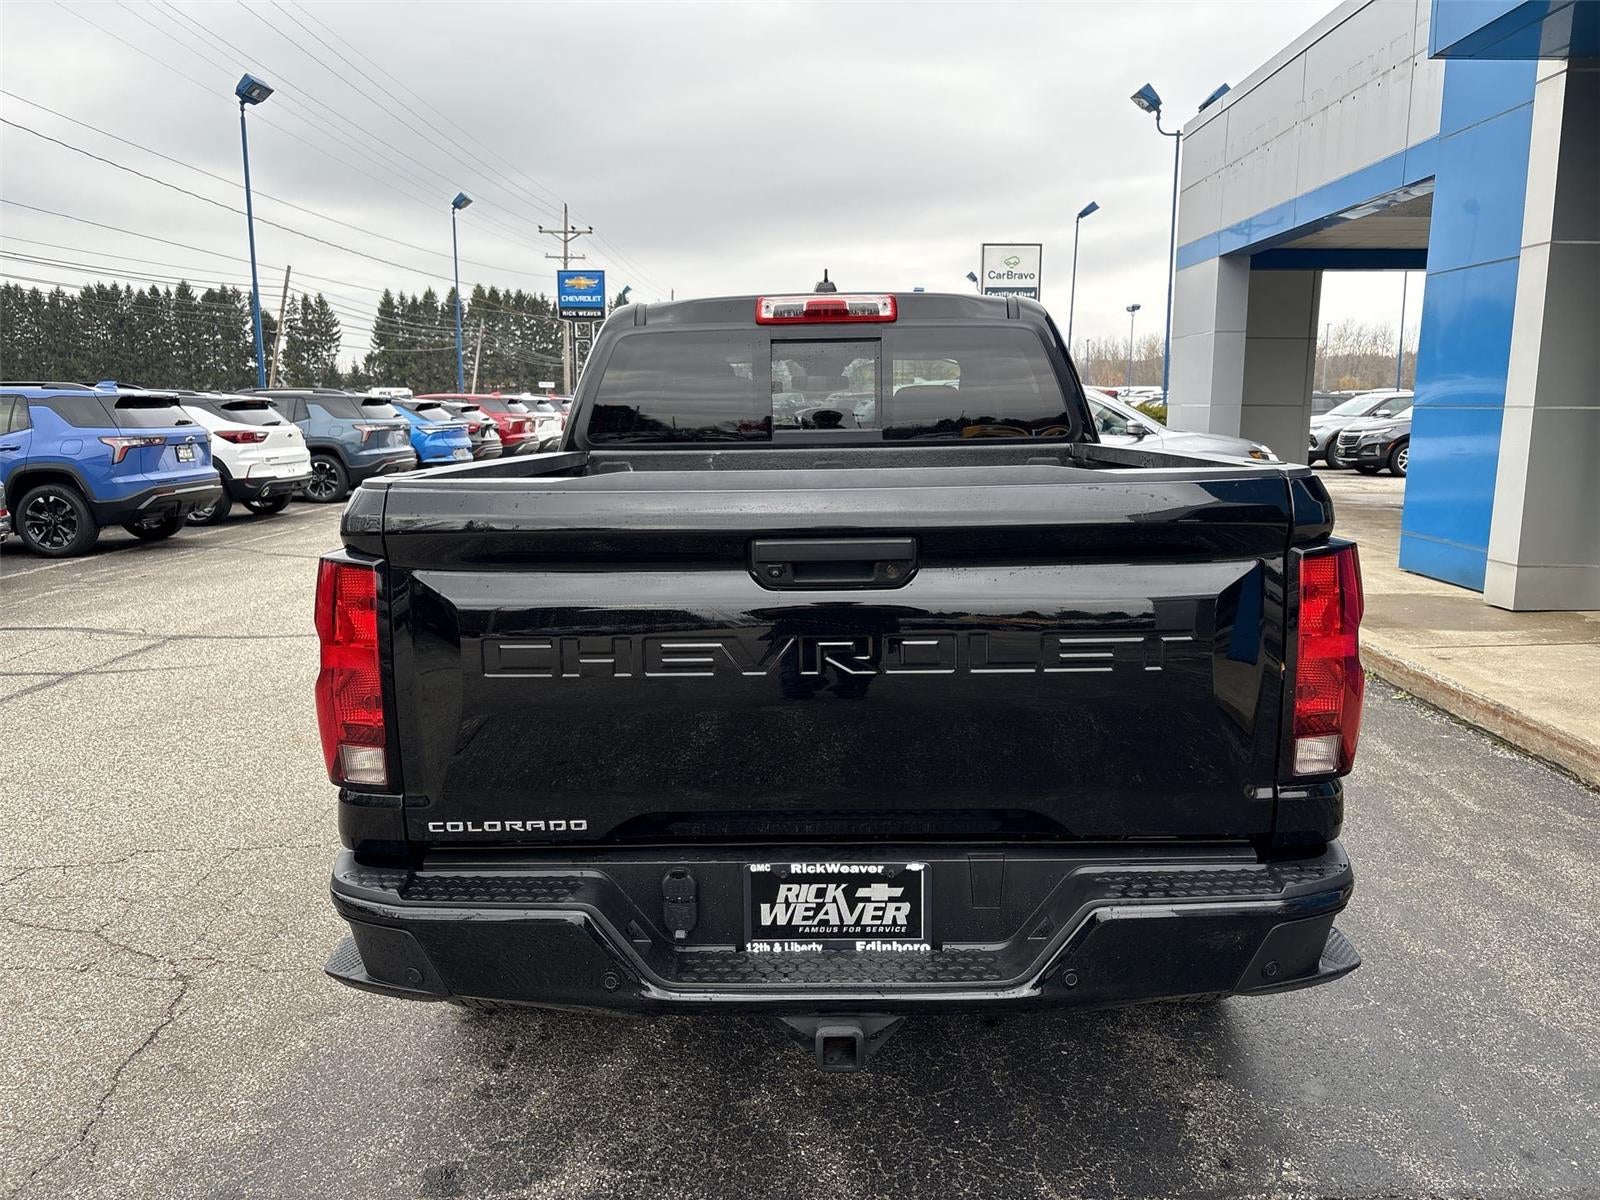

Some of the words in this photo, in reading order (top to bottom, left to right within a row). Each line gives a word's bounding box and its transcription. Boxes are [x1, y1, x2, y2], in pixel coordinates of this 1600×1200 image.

[988, 270, 1035, 279] CarBravo
[481, 630, 1196, 677] CHEVROLET
[428, 820, 588, 832] COLORADO
[750, 864, 771, 872] GMC
[776, 884, 849, 903] RICK
[760, 902, 911, 926] WEAVER
[746, 943, 771, 953] 12th
[773, 943, 782, 952] &
[784, 942, 823, 952] Liberty
[855, 941, 931, 951] Edinboro
